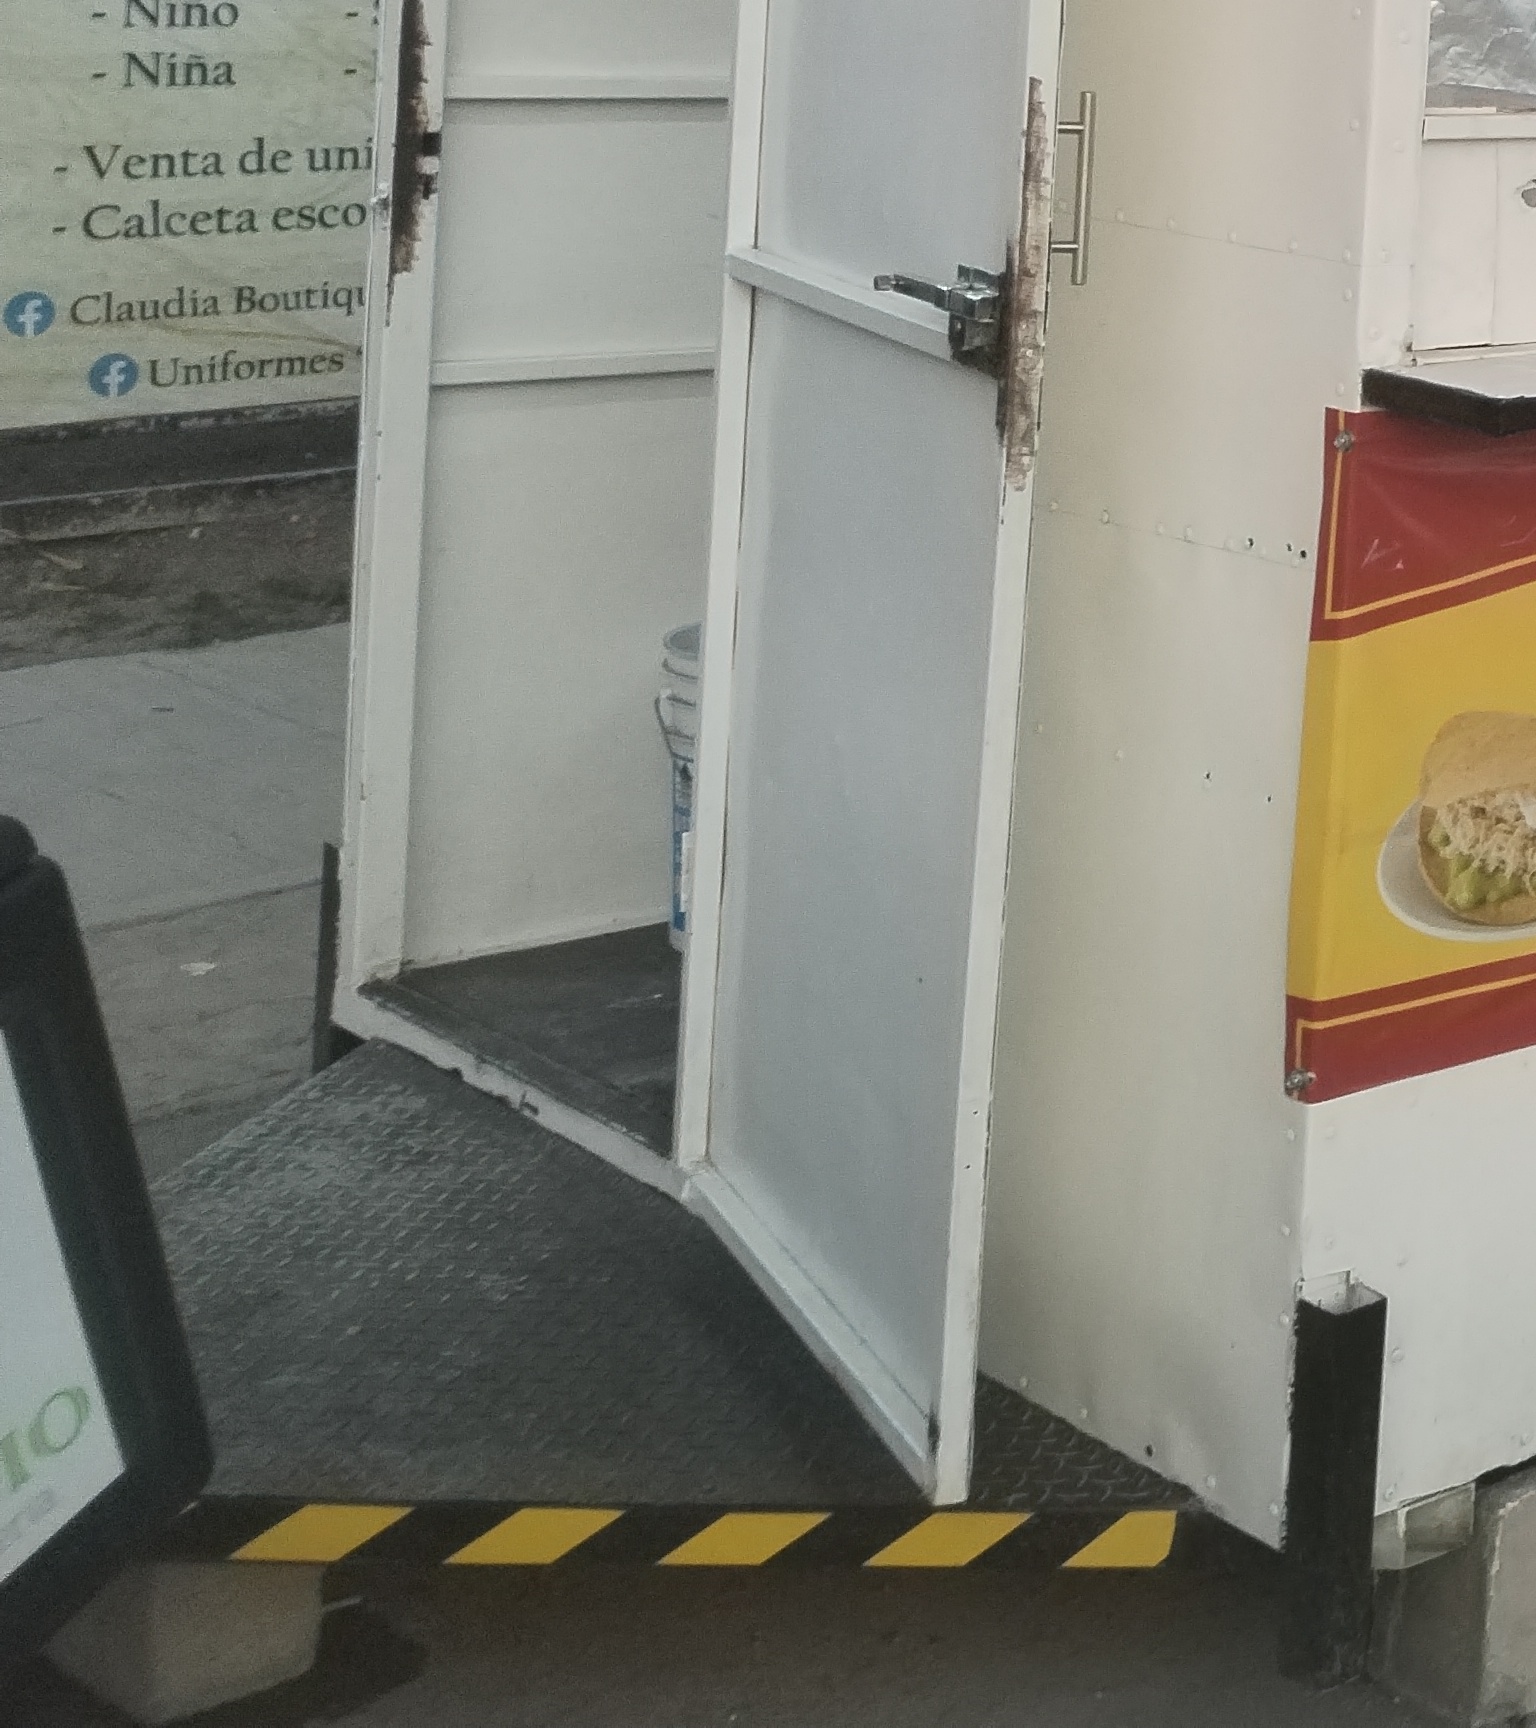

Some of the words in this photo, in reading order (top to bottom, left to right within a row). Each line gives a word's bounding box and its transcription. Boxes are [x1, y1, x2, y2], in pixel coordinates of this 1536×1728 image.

[123, 51, 237, 87] Niña
[82, 144, 226, 180] Venta
[238, 137, 293, 174] de
[81, 199, 260, 240] Calceta
[271, 201, 367, 232] esco
[69, 285, 221, 326] Claudia
[147, 349, 345, 389] Uniformes
